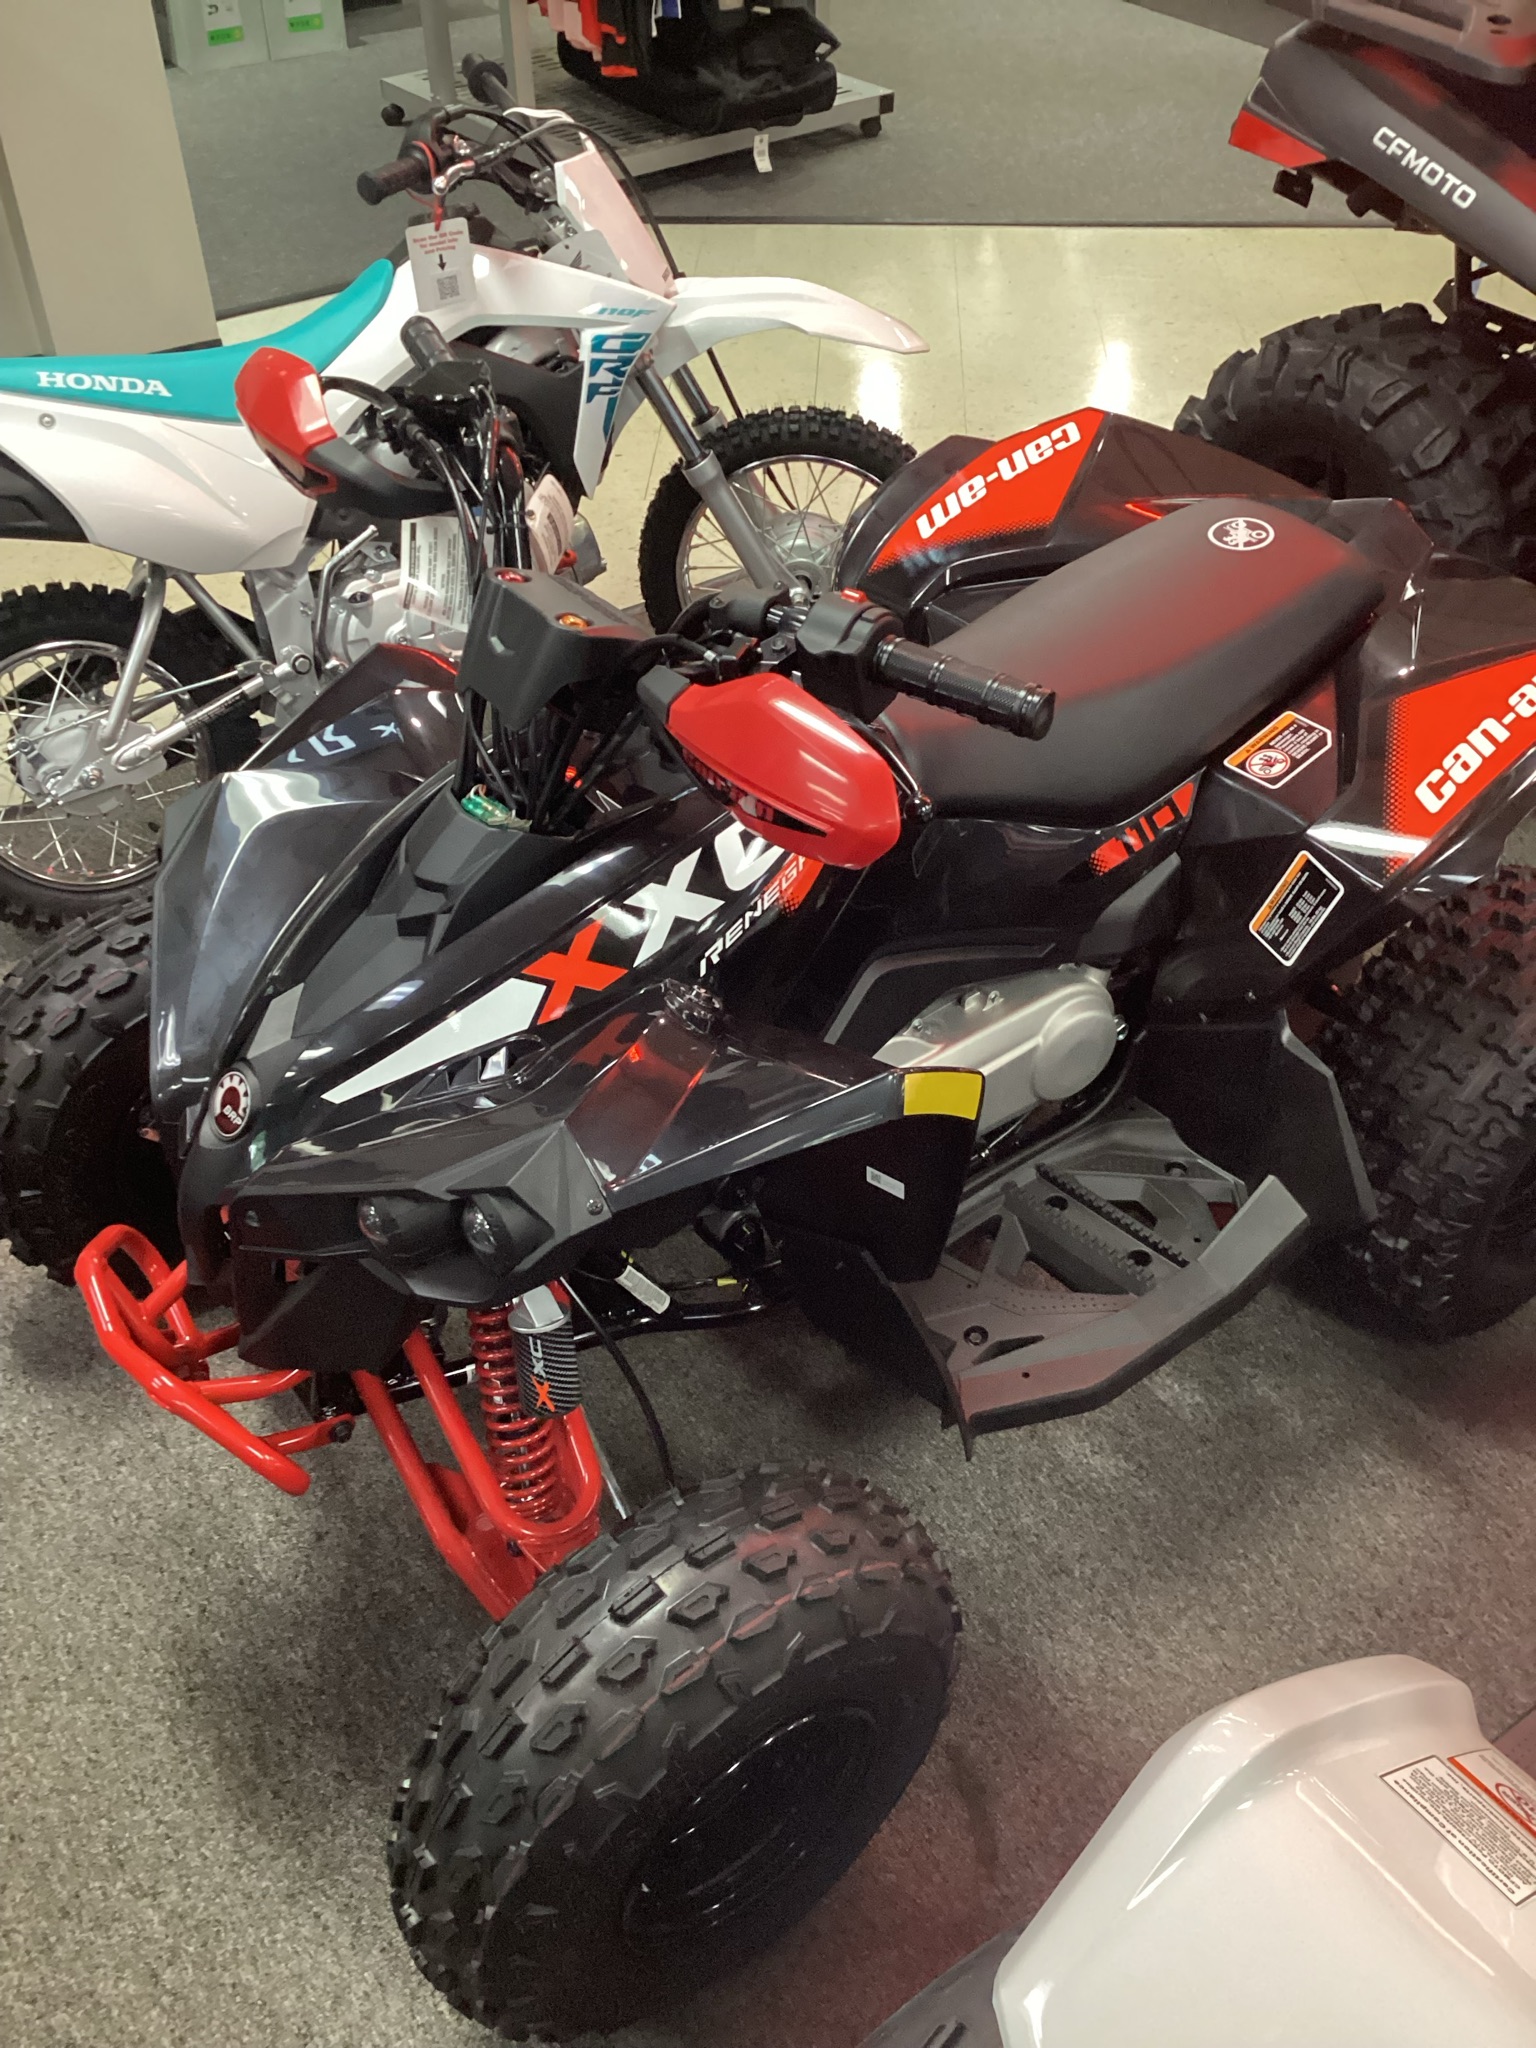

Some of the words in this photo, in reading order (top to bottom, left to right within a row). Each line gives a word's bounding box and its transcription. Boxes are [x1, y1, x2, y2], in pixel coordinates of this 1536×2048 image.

[1373, 126, 1477, 209] CFMOTO
[597, 307, 656, 317] 110F
[36, 371, 172, 397] HONDA
[916, 421, 1081, 539] can-am
[1249, 725, 1279, 749] WARNING
[1414, 675, 1536, 814] can-a
[223, 1104, 243, 1125] BRP
[1392, 1779, 1447, 1828] Compliance
[1456, 1839, 1515, 1894] Certification
